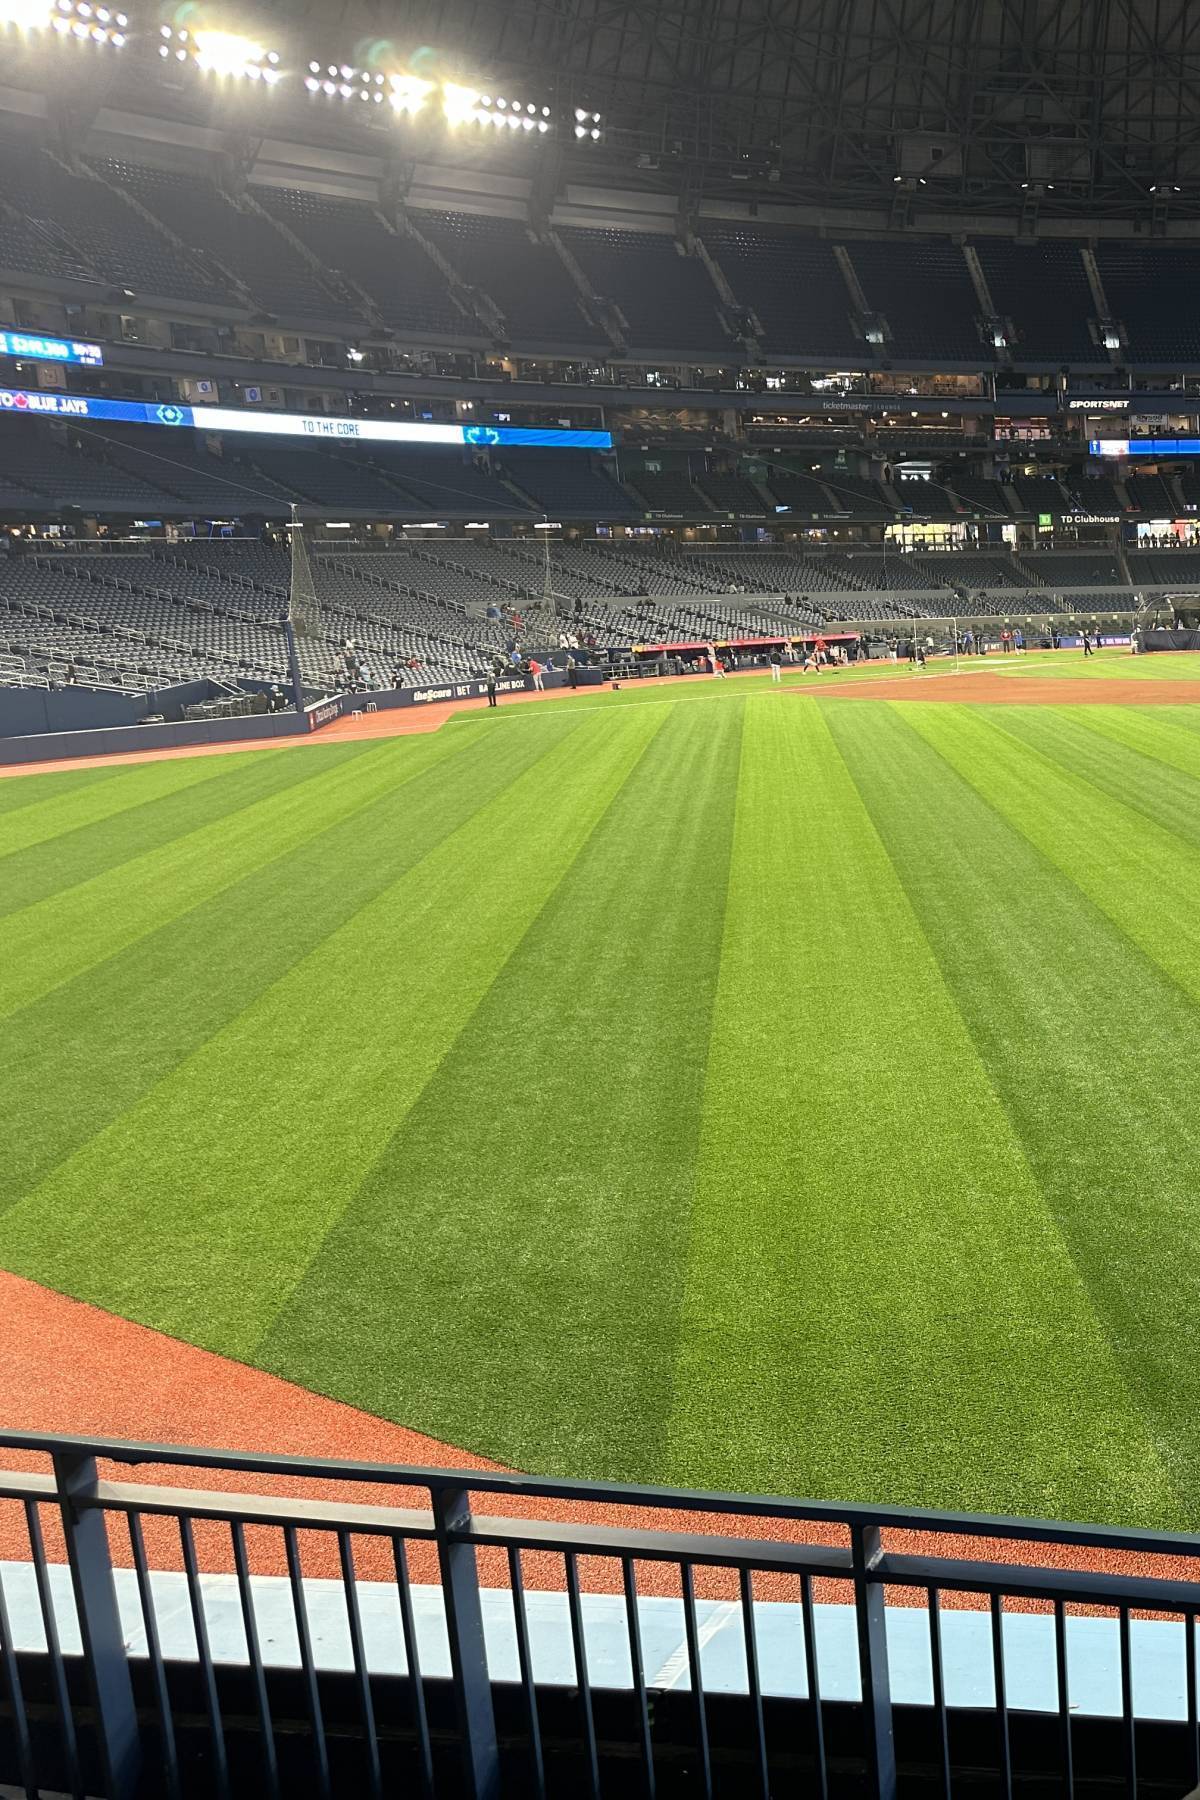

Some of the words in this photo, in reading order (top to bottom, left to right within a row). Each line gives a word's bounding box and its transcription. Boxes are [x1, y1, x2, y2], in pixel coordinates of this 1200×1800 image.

[27, 394, 58, 411] BLUE
[59, 399, 89, 414] JAYS
[823, 401, 869, 411] ticketmaster
[1069, 400, 1130, 409] SPORTSNET
[302, 420, 314, 433] TO
[316, 421, 335, 434] THE
[336, 423, 360, 436] CORE
[1060, 515, 1073, 523] TD
[1074, 515, 1120, 523] Clubhouse
[413, 689, 452, 702] theScore
[457, 685, 471, 696] BET
[478, 681, 511, 693] BALINE
[511, 680, 525, 689] BOX
